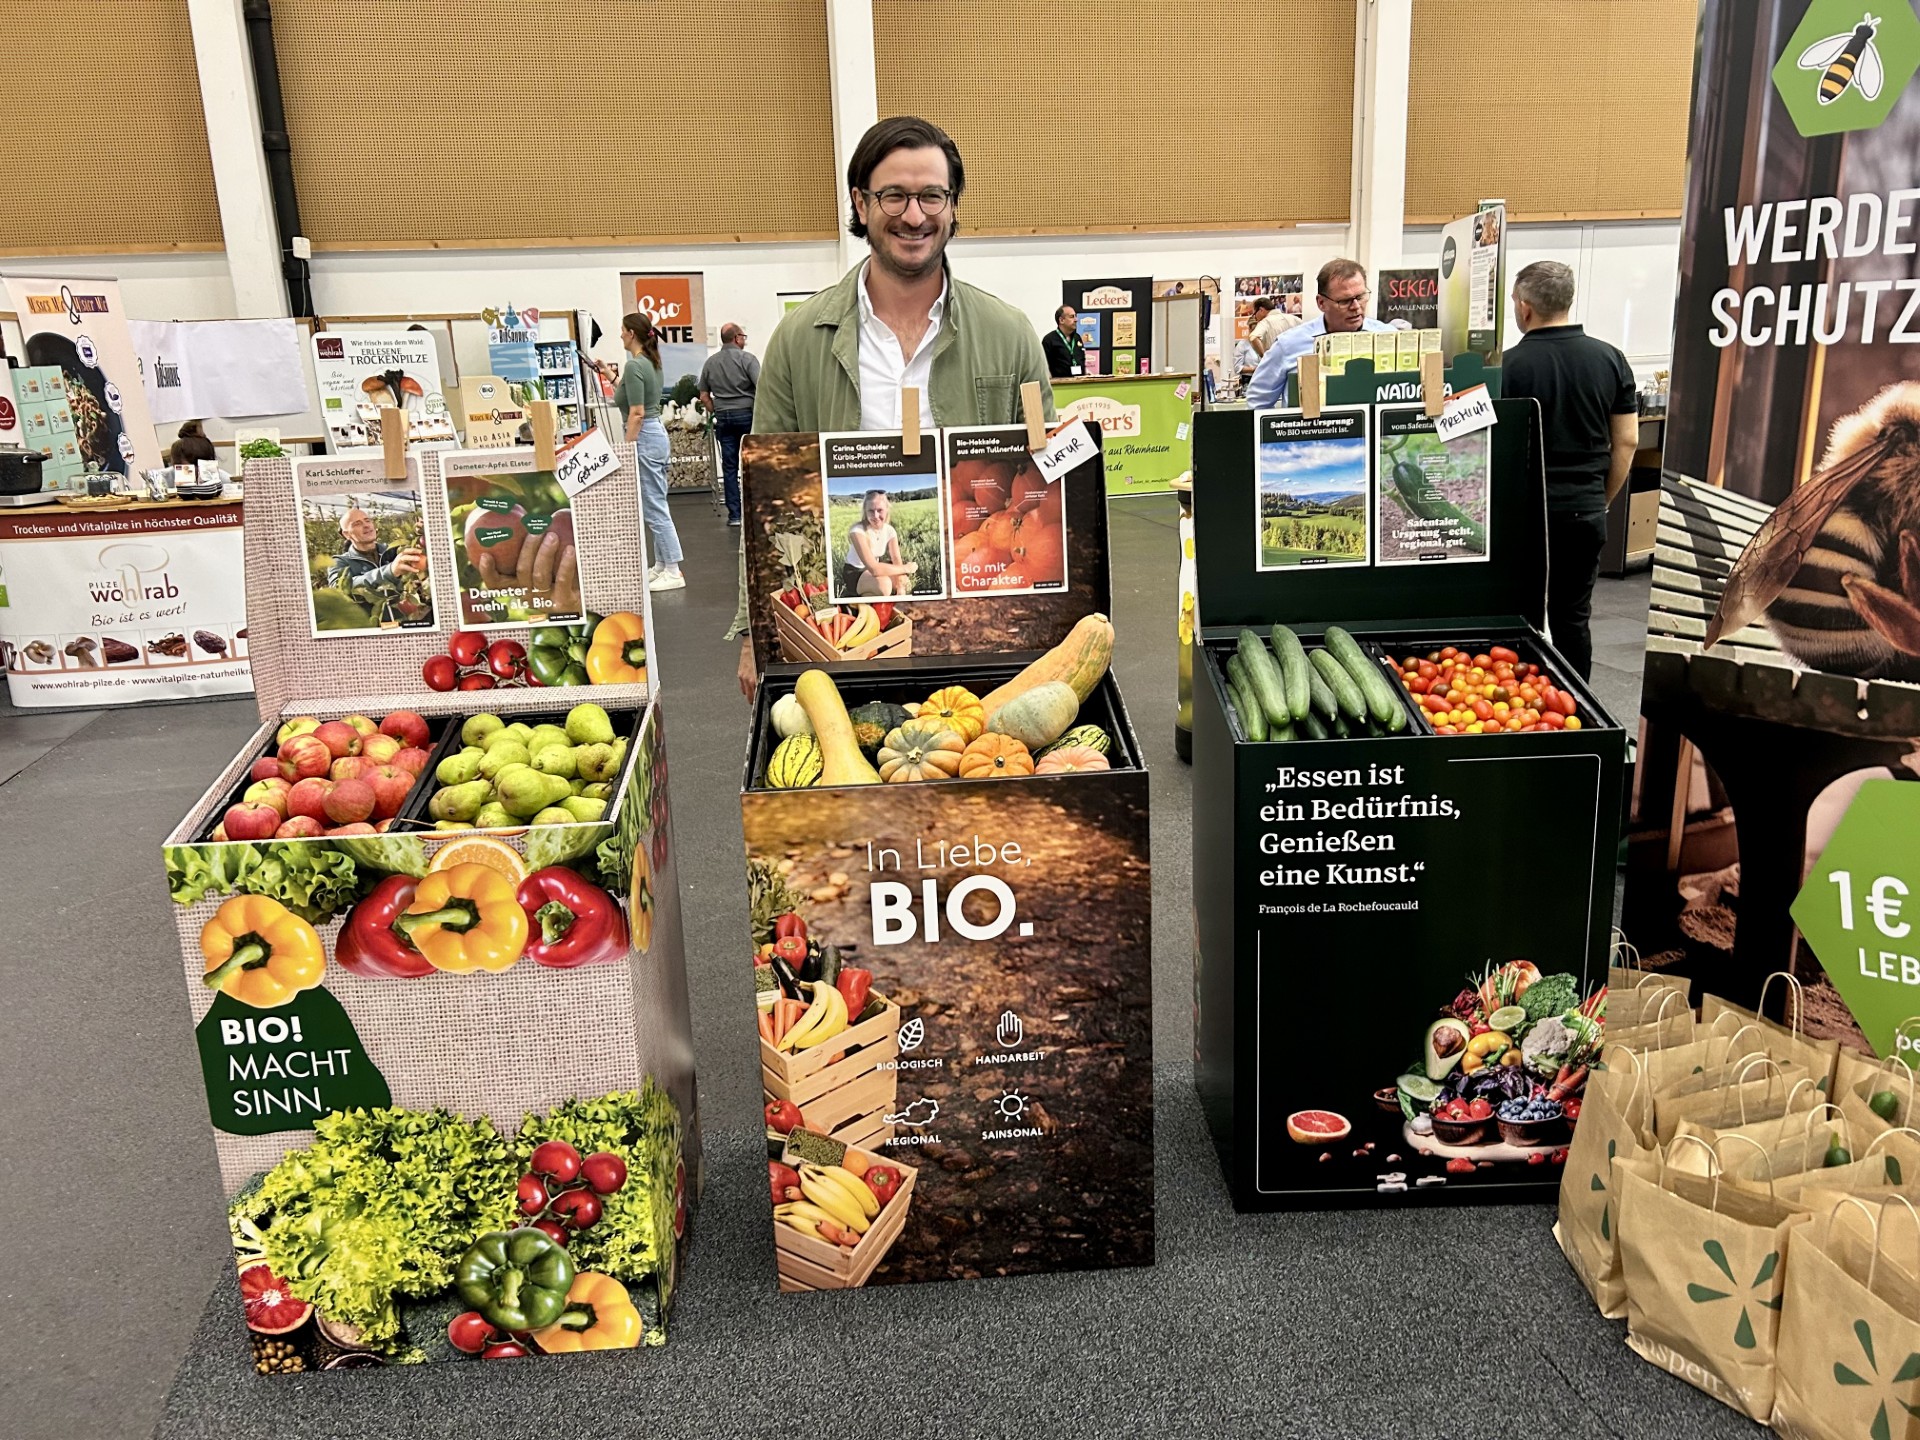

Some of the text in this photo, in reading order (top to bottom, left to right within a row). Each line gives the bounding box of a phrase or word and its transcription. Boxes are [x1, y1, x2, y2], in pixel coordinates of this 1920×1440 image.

[638, 295, 683, 327] Bio
[1388, 303, 1438, 312] KAMILLENERNT
[655, 326, 694, 344] NTE
[361, 347, 403, 356] ERLESENE
[348, 354, 429, 365] TROCKENPILZE
[1124, 444, 1170, 456] Rheinhessen
[305, 469, 324, 478] Karl
[12, 513, 238, 535] Trocken- und Vitalpilze in höchster Qualität
[960, 562, 1007, 574] Bio mit
[88, 581, 118, 589] PILZE
[90, 571, 179, 604] wohlrab
[961, 574, 1025, 587] Charakter.
[469, 587, 528, 599] Demeter
[471, 597, 557, 612] mehr als Bio.
[91, 601, 187, 627] Bio ist es wert!
[31, 678, 126, 690] www.wohlrab-pilze.de
[1367, 763, 1405, 786] ist
[1259, 794, 1461, 822] ein Bedürfnis,
[1259, 829, 1396, 855] Genießen
[867, 834, 1032, 872] In Liebe,
[1259, 864, 1320, 886] eine
[870, 874, 1035, 946] BIO.
[1258, 900, 1419, 916] François de La Rochefoucauld
[220, 1016, 304, 1046] BIO!
[229, 1049, 351, 1081] MACHT
[875, 1058, 944, 1072] BIOLOGISCH
[975, 1051, 1046, 1065] HANDARBEIT
[233, 1086, 331, 1116] SINN.
[885, 1134, 942, 1147] REGIONAL
[981, 1127, 1044, 1141] SAINSONAL
